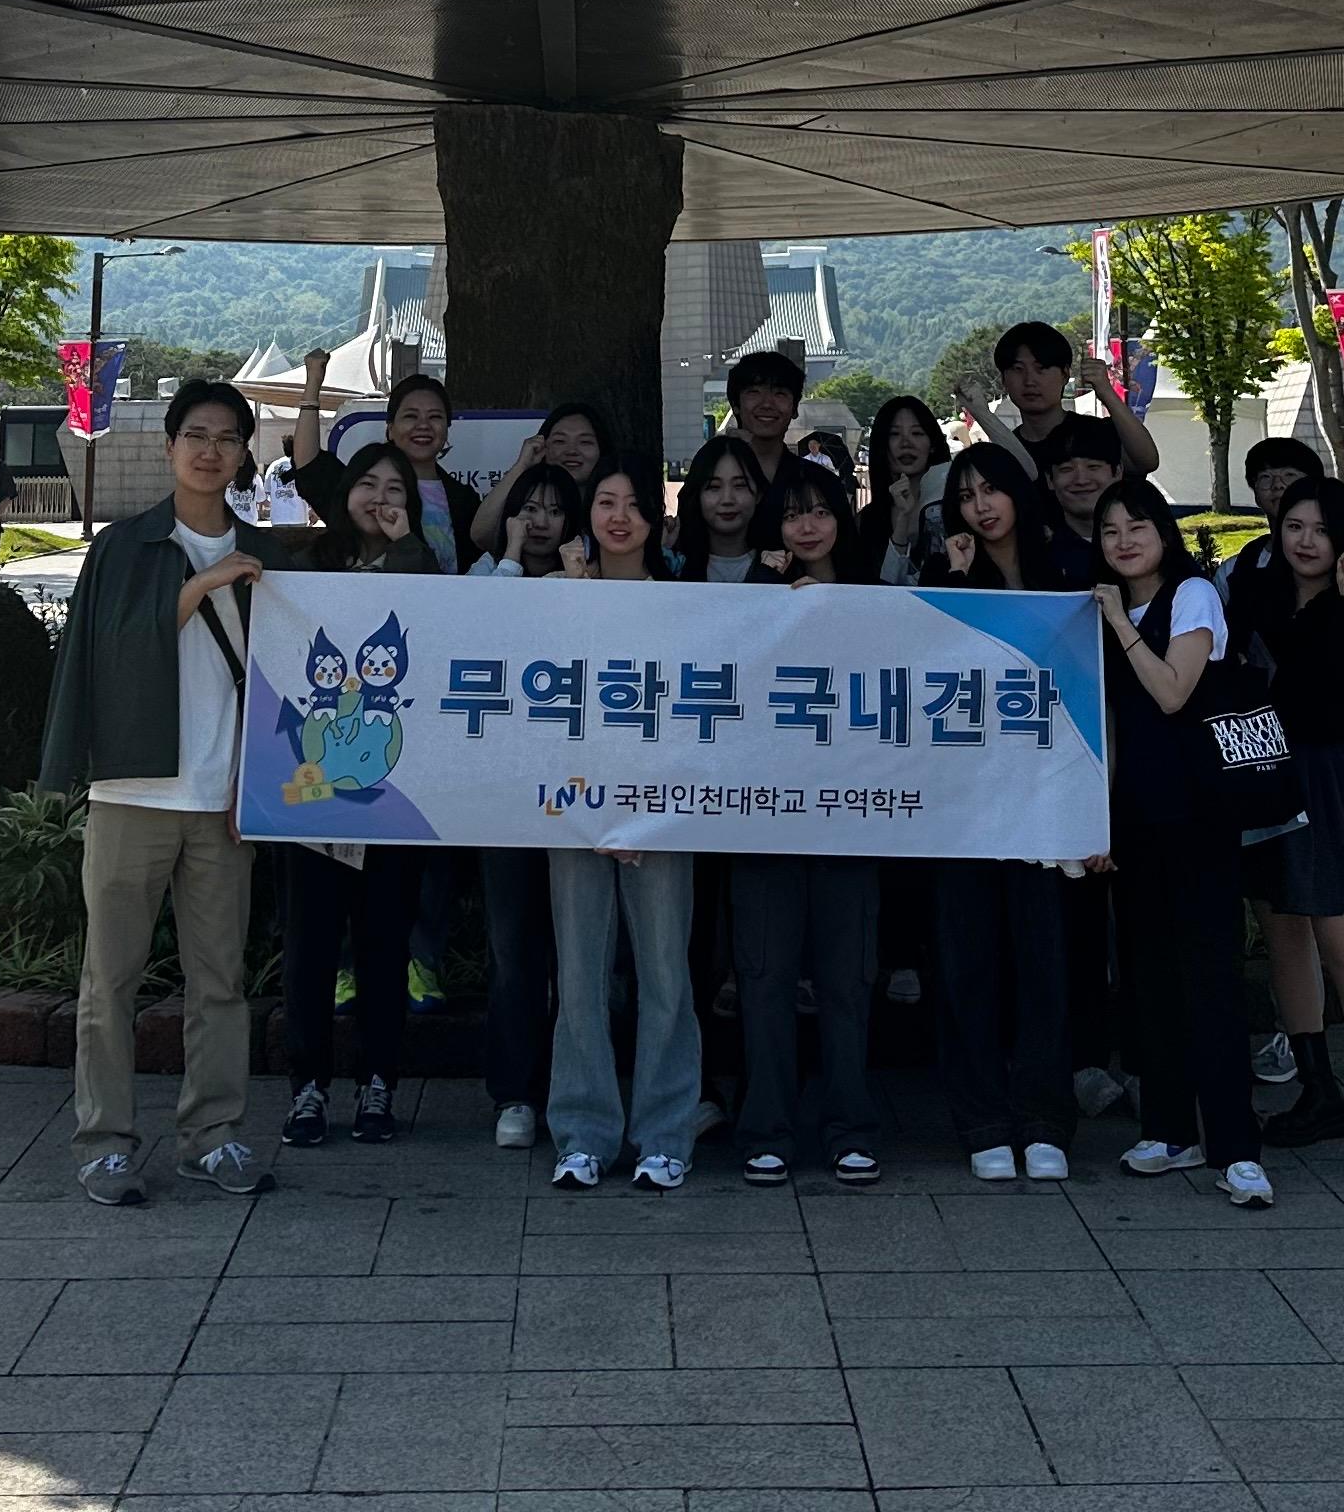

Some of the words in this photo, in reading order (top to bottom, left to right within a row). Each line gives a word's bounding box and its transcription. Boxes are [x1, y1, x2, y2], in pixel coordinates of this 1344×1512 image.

[440, 657, 744, 745] 무역학부
[767, 662, 1061, 750] 국내견학
[1222, 736, 1289, 763] GIRBAU
[537, 775, 606, 816] INU
[613, 783, 808, 817] 국립인천대학교
[815, 787, 925, 820] 무역학부
